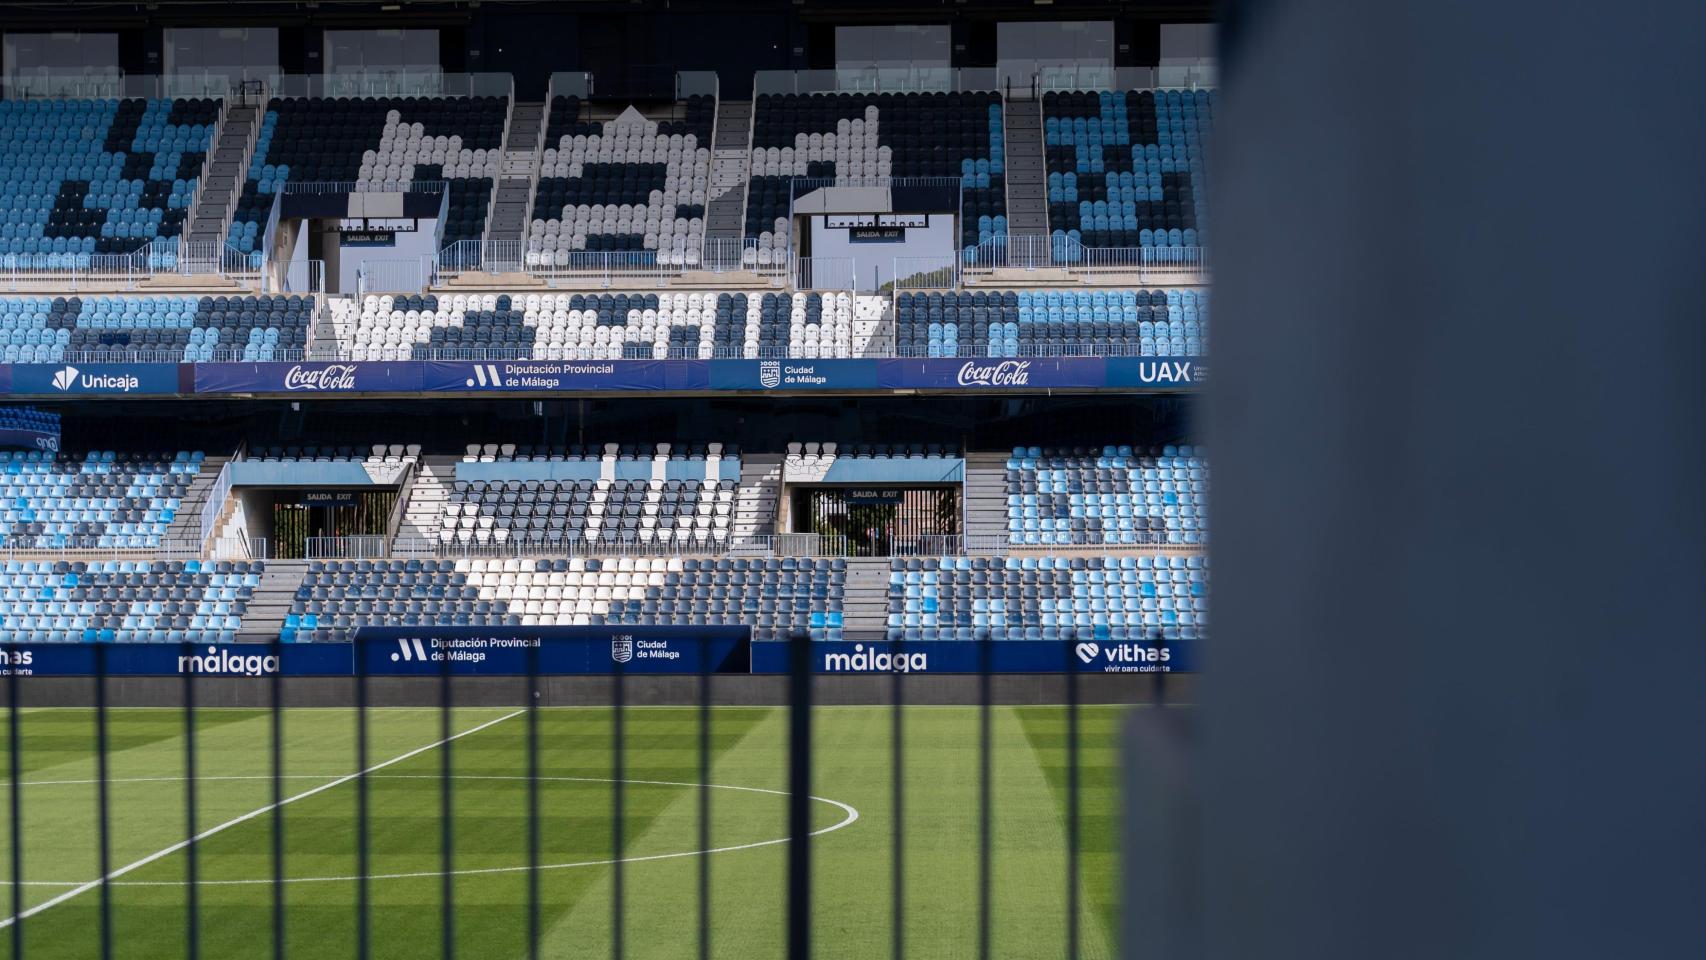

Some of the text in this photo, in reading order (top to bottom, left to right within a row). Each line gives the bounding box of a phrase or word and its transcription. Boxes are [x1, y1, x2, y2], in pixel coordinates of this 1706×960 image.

[505, 363, 613, 376] Diputación Provincial
[784, 366, 814, 375] Ciudad
[957, 361, 1031, 386] Coca-Cola
[1139, 362, 1191, 383] UAX
[82, 373, 138, 392] Unicaja
[284, 364, 358, 390] Coca-Cola
[505, 376, 559, 389] de Málaga
[784, 375, 826, 385] de Málaga
[431, 637, 541, 650] Diputación Provincial
[637, 640, 667, 649] Ciudad
[431, 650, 486, 662] de Málaga
[637, 649, 679, 660] de Málaga
[1104, 643, 1171, 662] vithas
